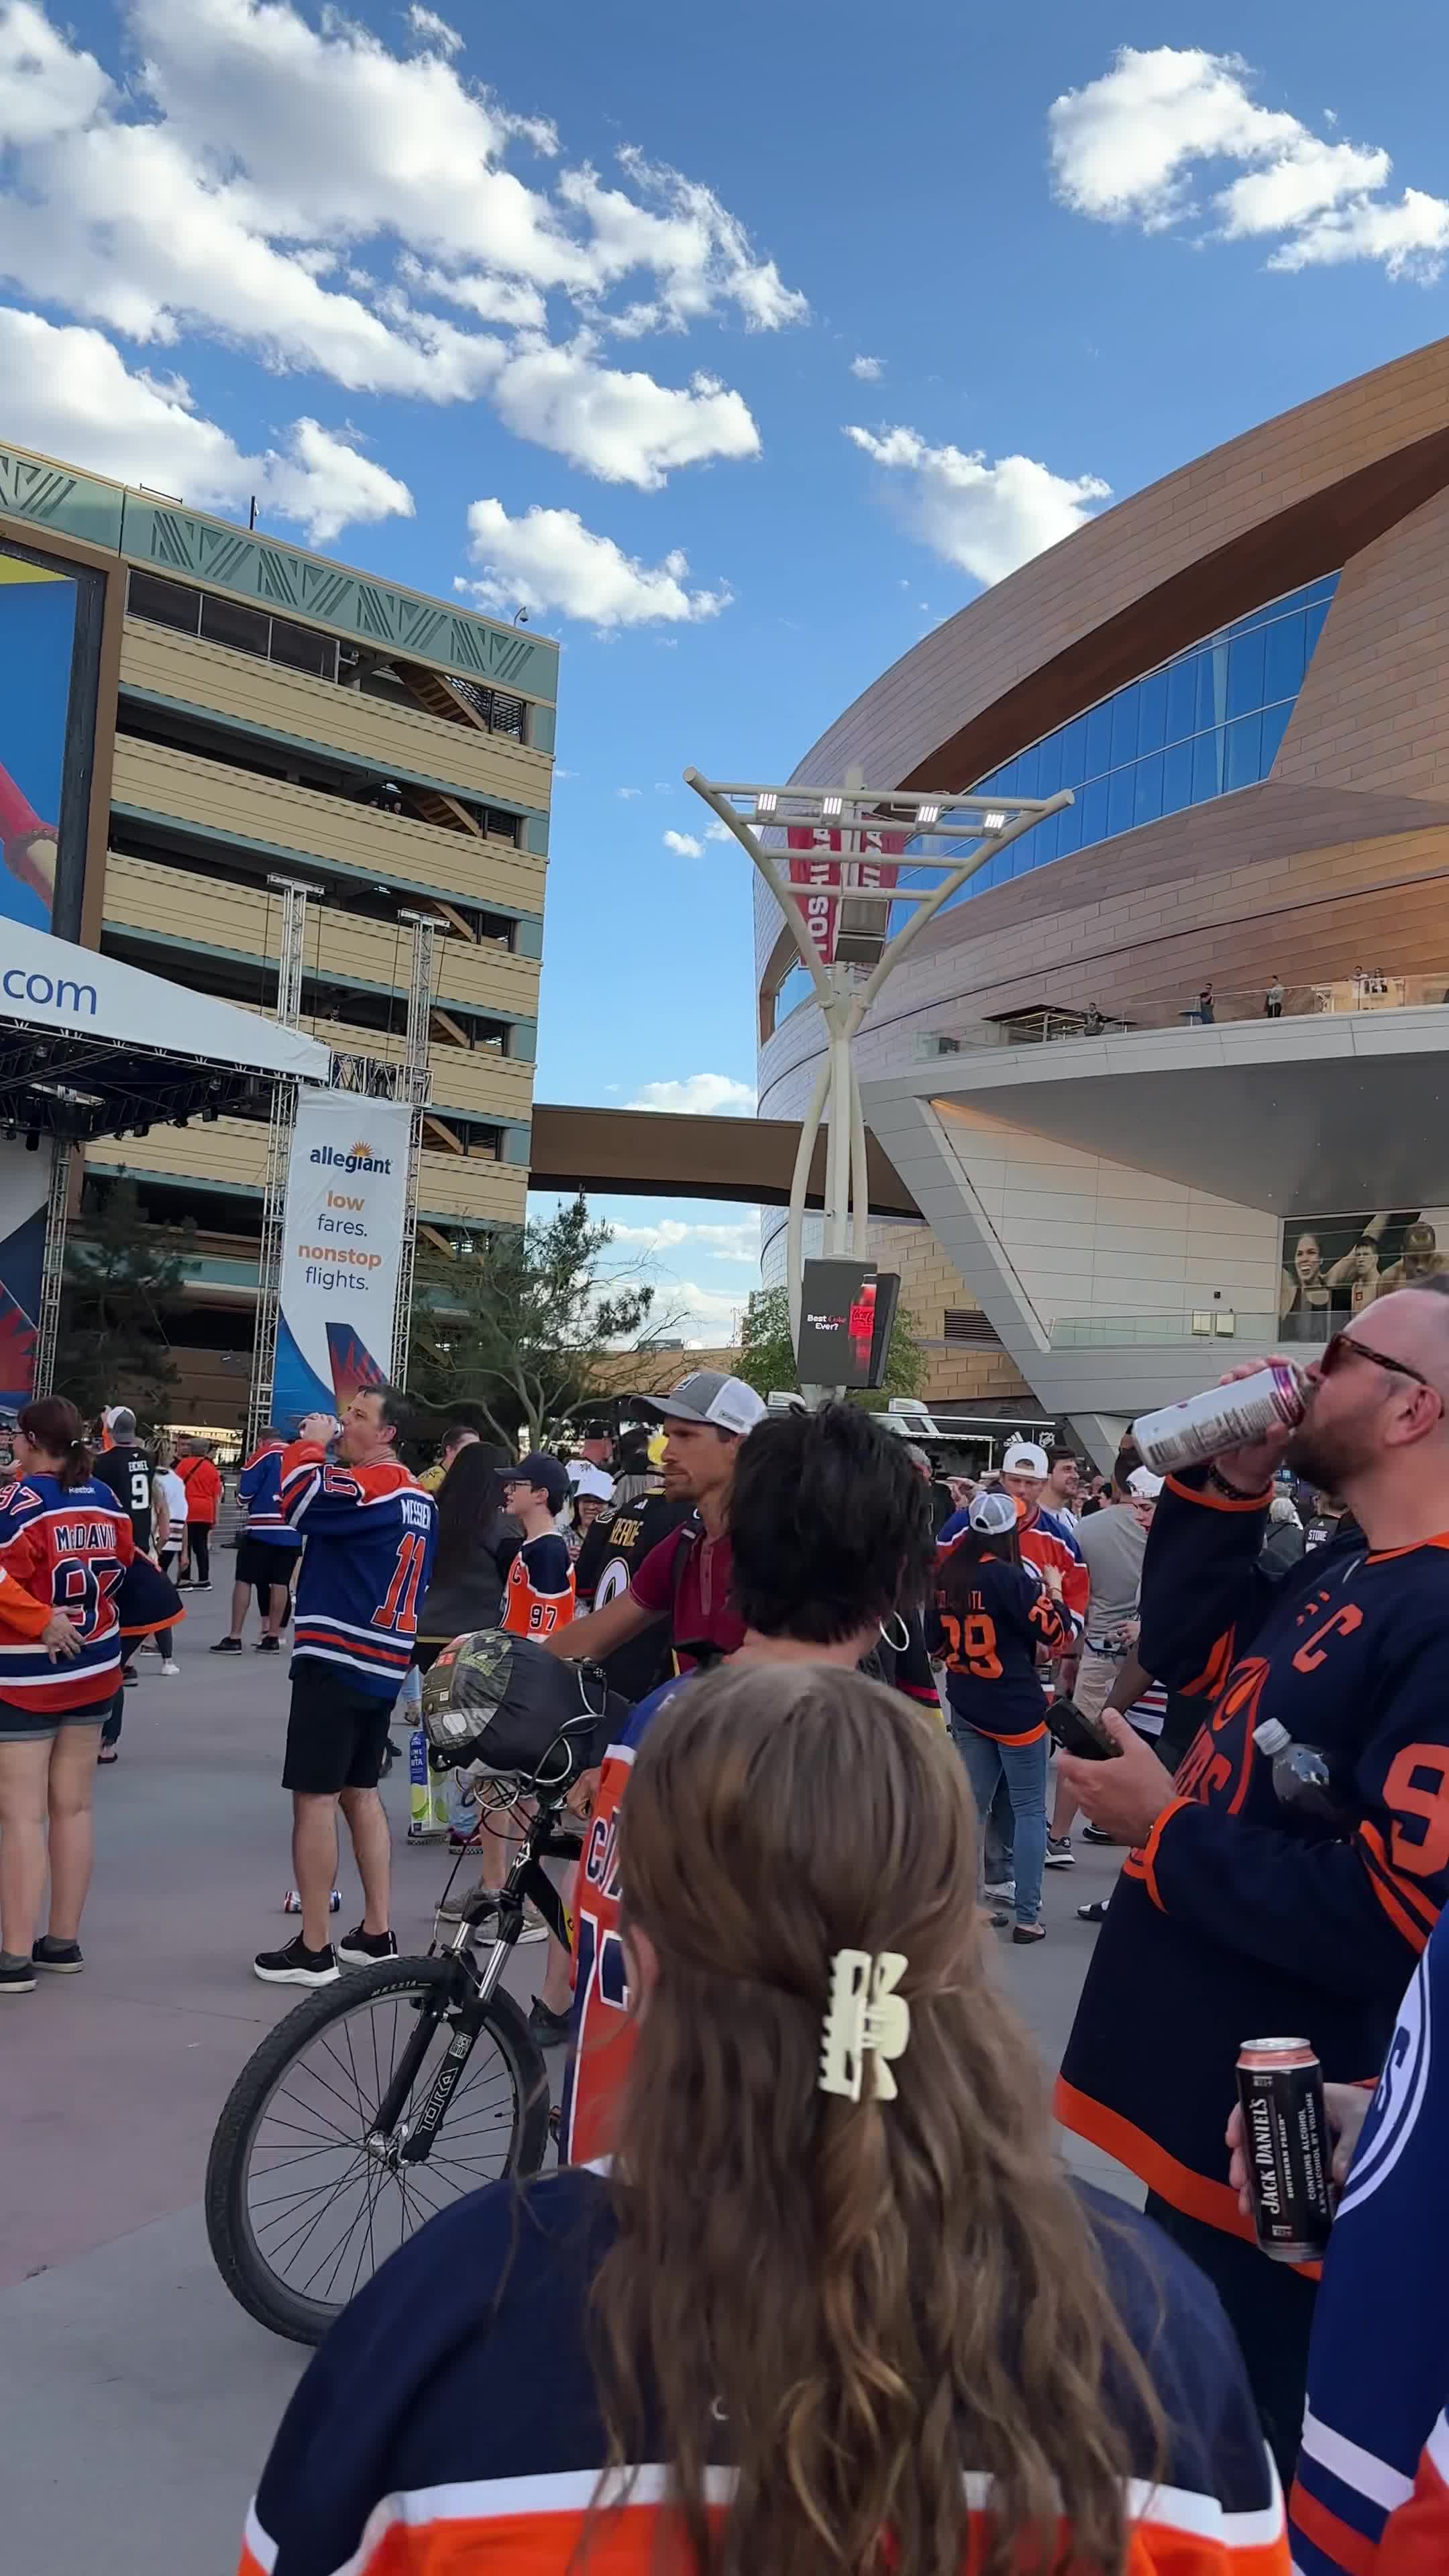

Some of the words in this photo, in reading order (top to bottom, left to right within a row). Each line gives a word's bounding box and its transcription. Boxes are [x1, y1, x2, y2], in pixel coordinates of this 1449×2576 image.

[310, 1146, 392, 1175] allegiant
[327, 1190, 365, 1211] low
[317, 1214, 368, 1236] fares.
[298, 1244, 382, 1270] nonstop
[306, 1267, 369, 1290] flights.
[807, 1314, 827, 1322] Best
[131, 1474, 149, 1509] 9
[400, 1499, 431, 1530] MESSIER
[52, 1556, 127, 1644] 97
[370, 1531, 426, 1633] 11
[529, 1603, 558, 1631] 97
[1292, 1603, 1364, 1673] C
[415, 2067, 460, 2135] TORA
[1305, 2092, 1317, 2130] VOLUME
[1298, 2108, 1310, 2150] ALCOHOL
[1261, 2169, 1280, 2214] JACK
[1282, 2151, 1294, 2198] SOUTHERN
[1303, 2153, 1316, 2200] CONTAINS
